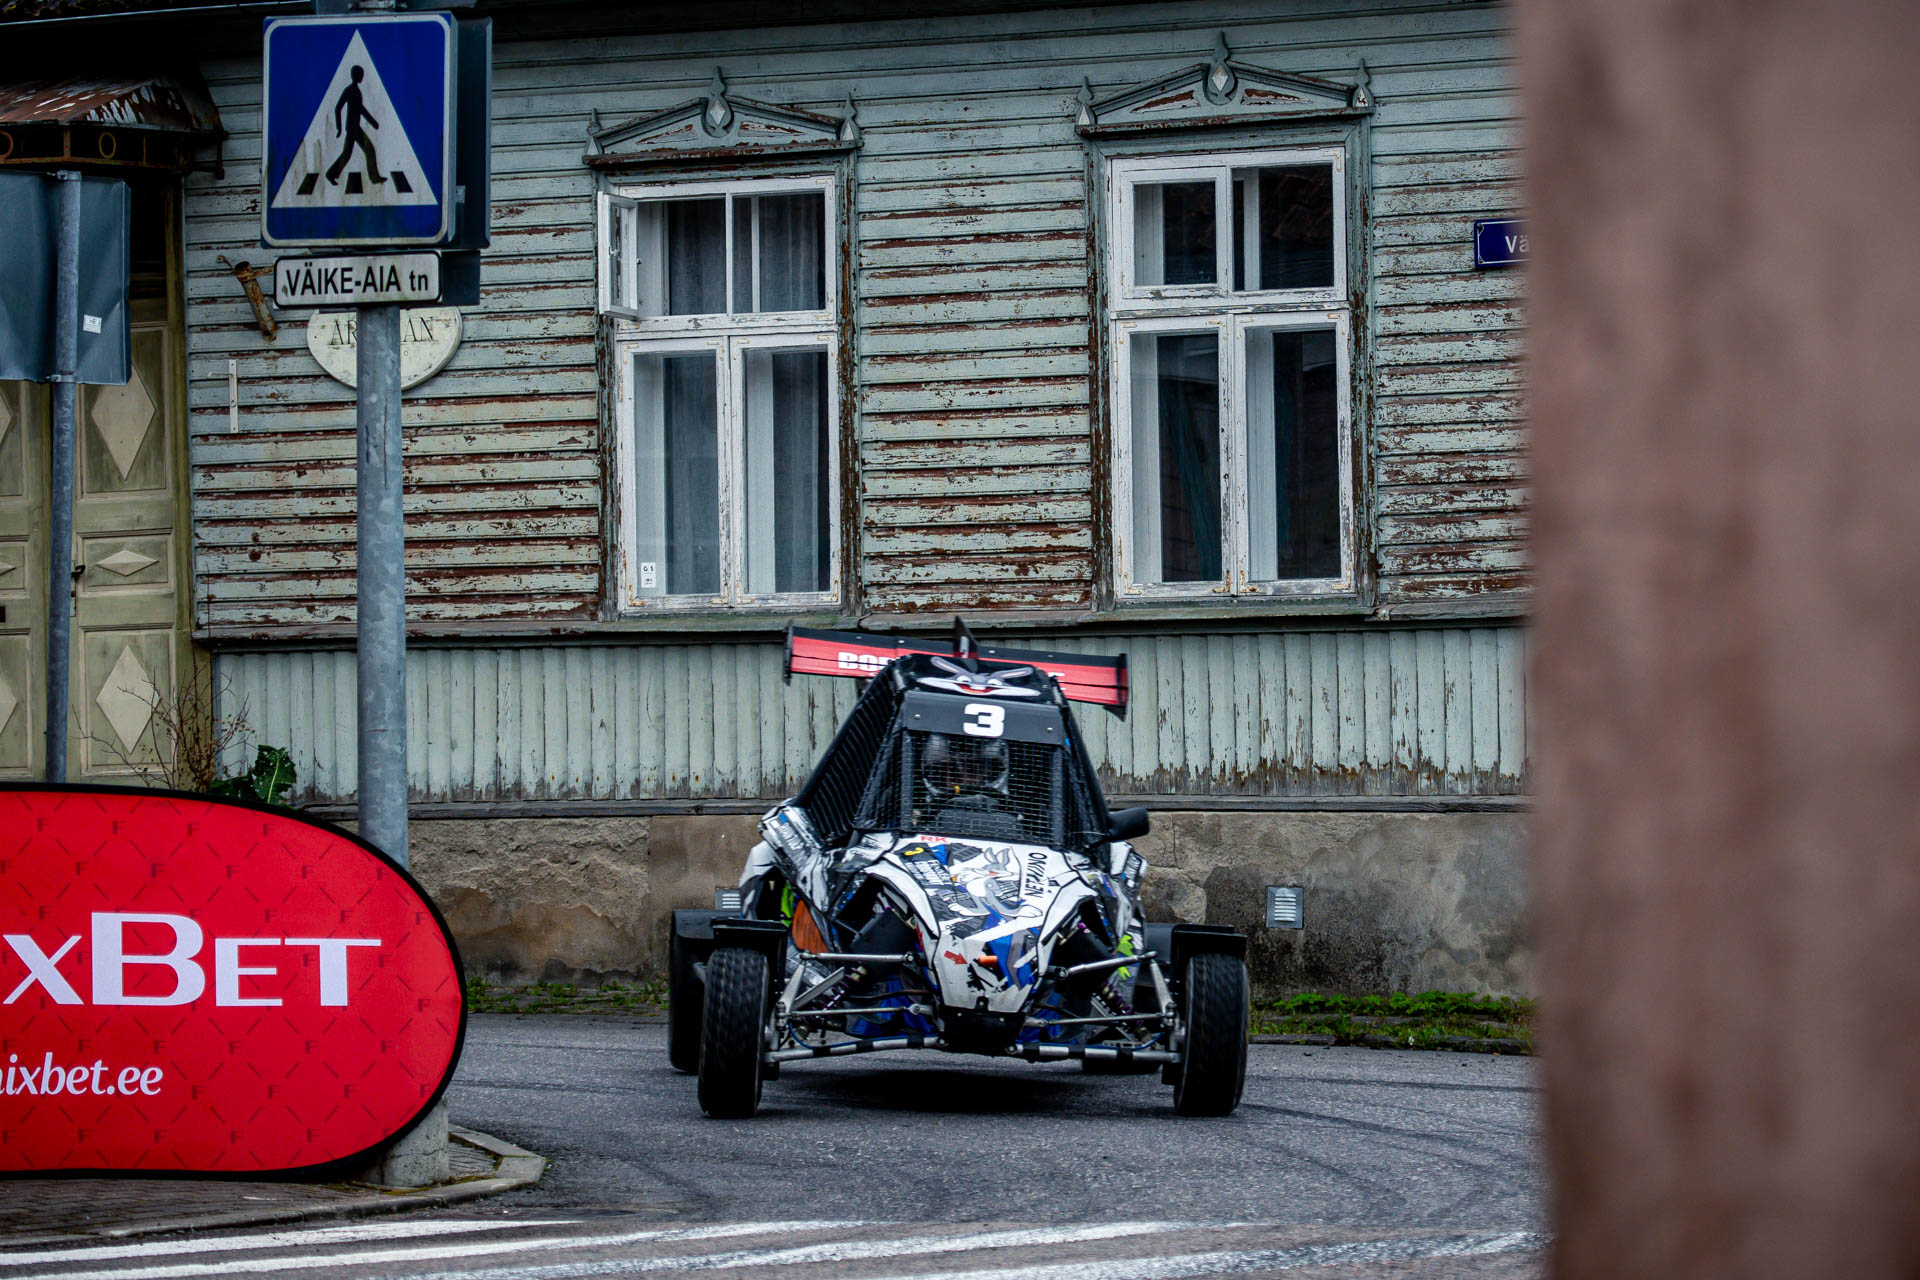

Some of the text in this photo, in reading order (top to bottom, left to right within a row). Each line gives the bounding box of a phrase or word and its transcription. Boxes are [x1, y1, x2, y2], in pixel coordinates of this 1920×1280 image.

[286, 262, 428, 296] VÄIKE-AIA tn
[963, 703, 1005, 737] 3
